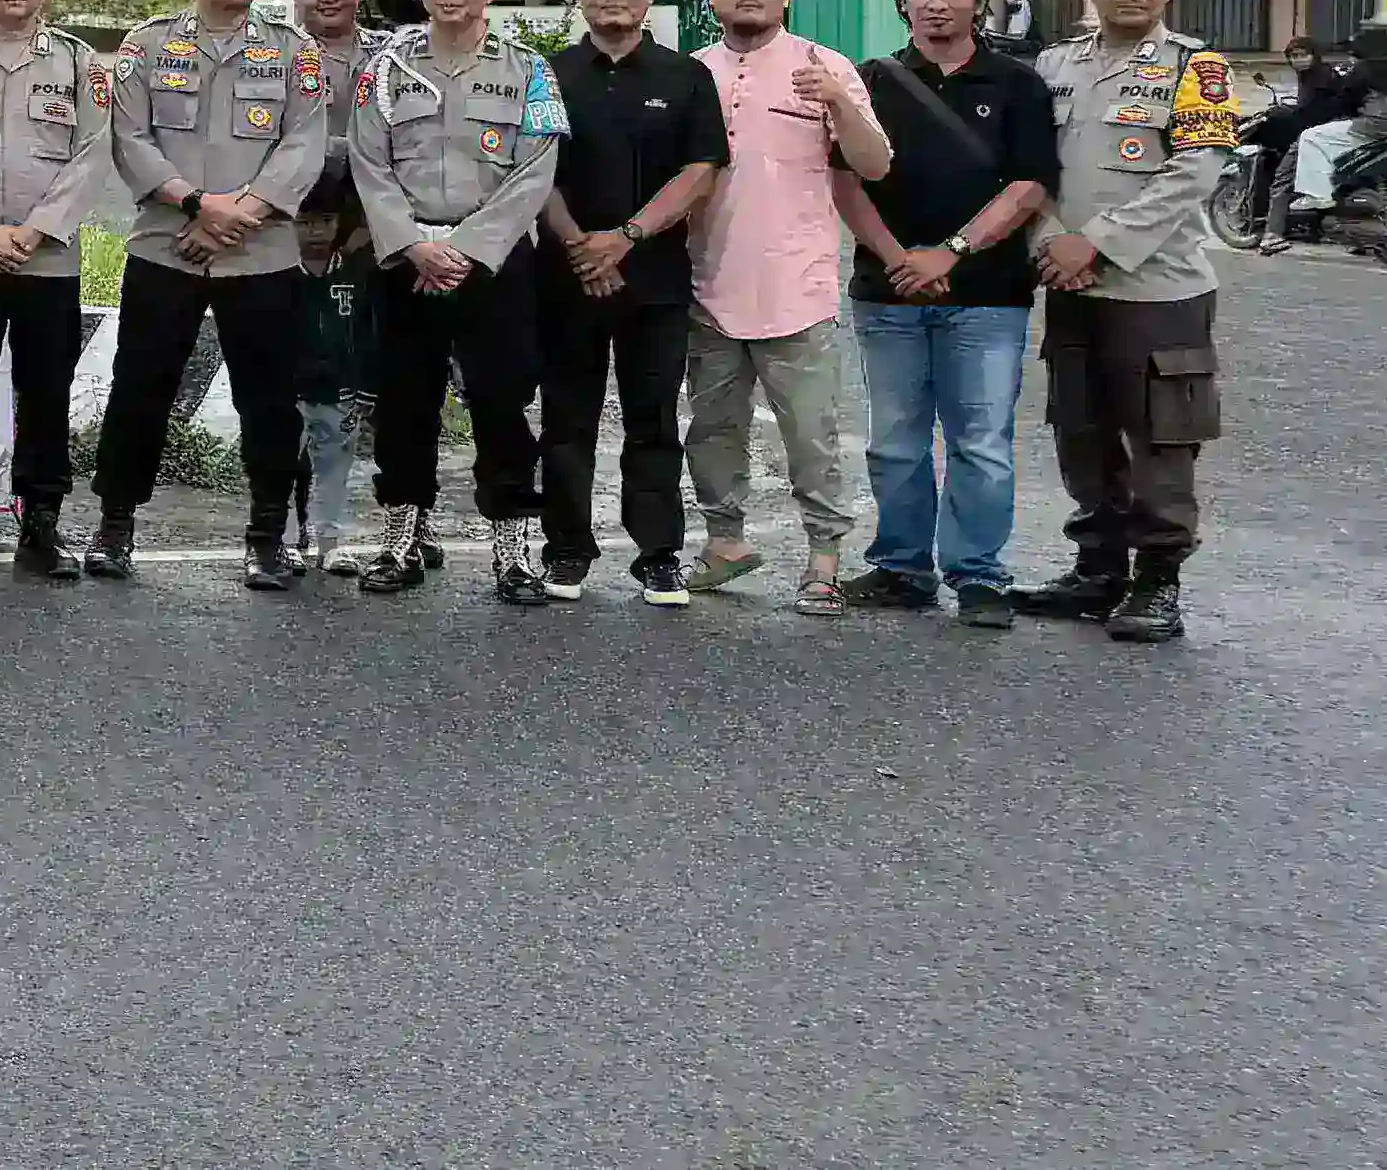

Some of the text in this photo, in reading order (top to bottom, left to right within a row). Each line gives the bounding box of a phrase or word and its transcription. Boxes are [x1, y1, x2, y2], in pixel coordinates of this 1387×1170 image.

[239, 66, 283, 79] POLRI
[472, 82, 518, 99] POLRI
[1119, 85, 1171, 101] POLRI
